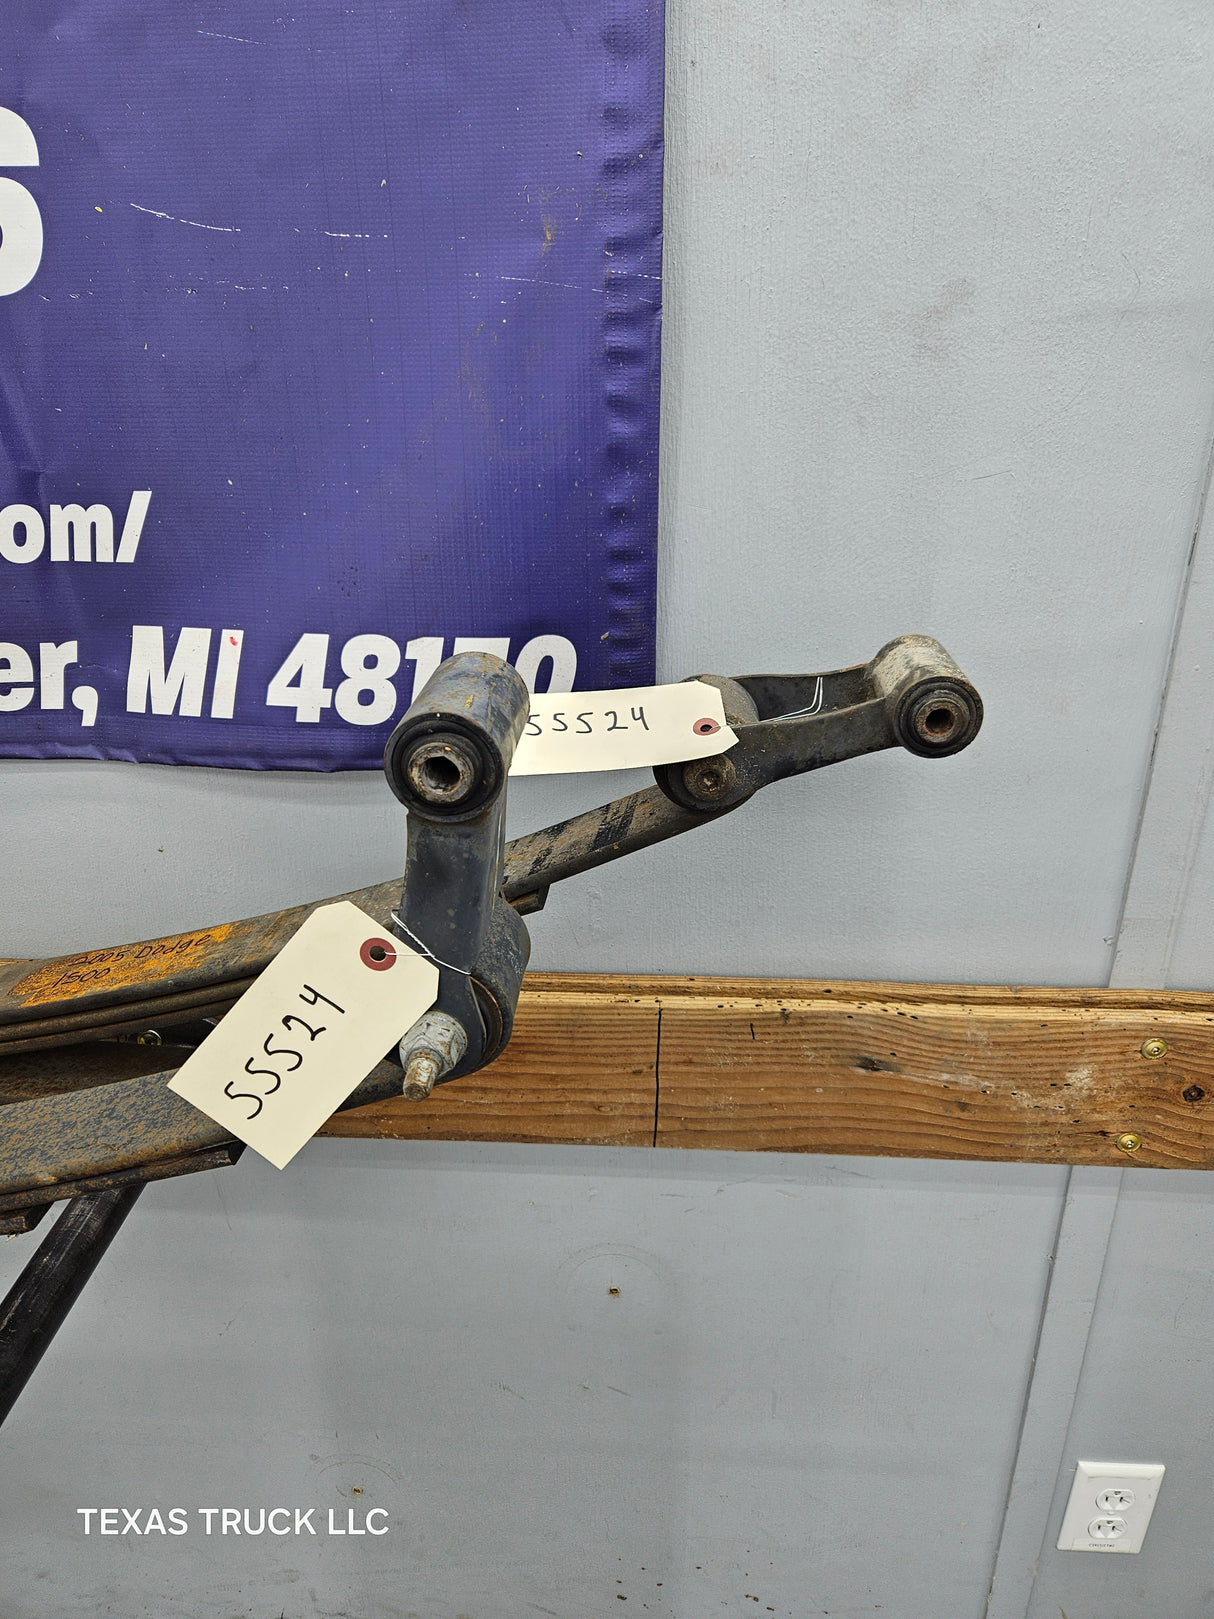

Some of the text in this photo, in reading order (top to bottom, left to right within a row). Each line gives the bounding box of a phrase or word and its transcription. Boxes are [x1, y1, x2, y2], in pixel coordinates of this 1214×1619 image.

[0, 490, 152, 564] om/
[0, 640, 98, 726] er,
[126, 625, 244, 719] MI
[525, 706, 650, 735] 55524
[67, 934, 212, 967] 2005 Dodge
[52, 967, 111, 988] 1500
[224, 984, 345, 1119] 55524
